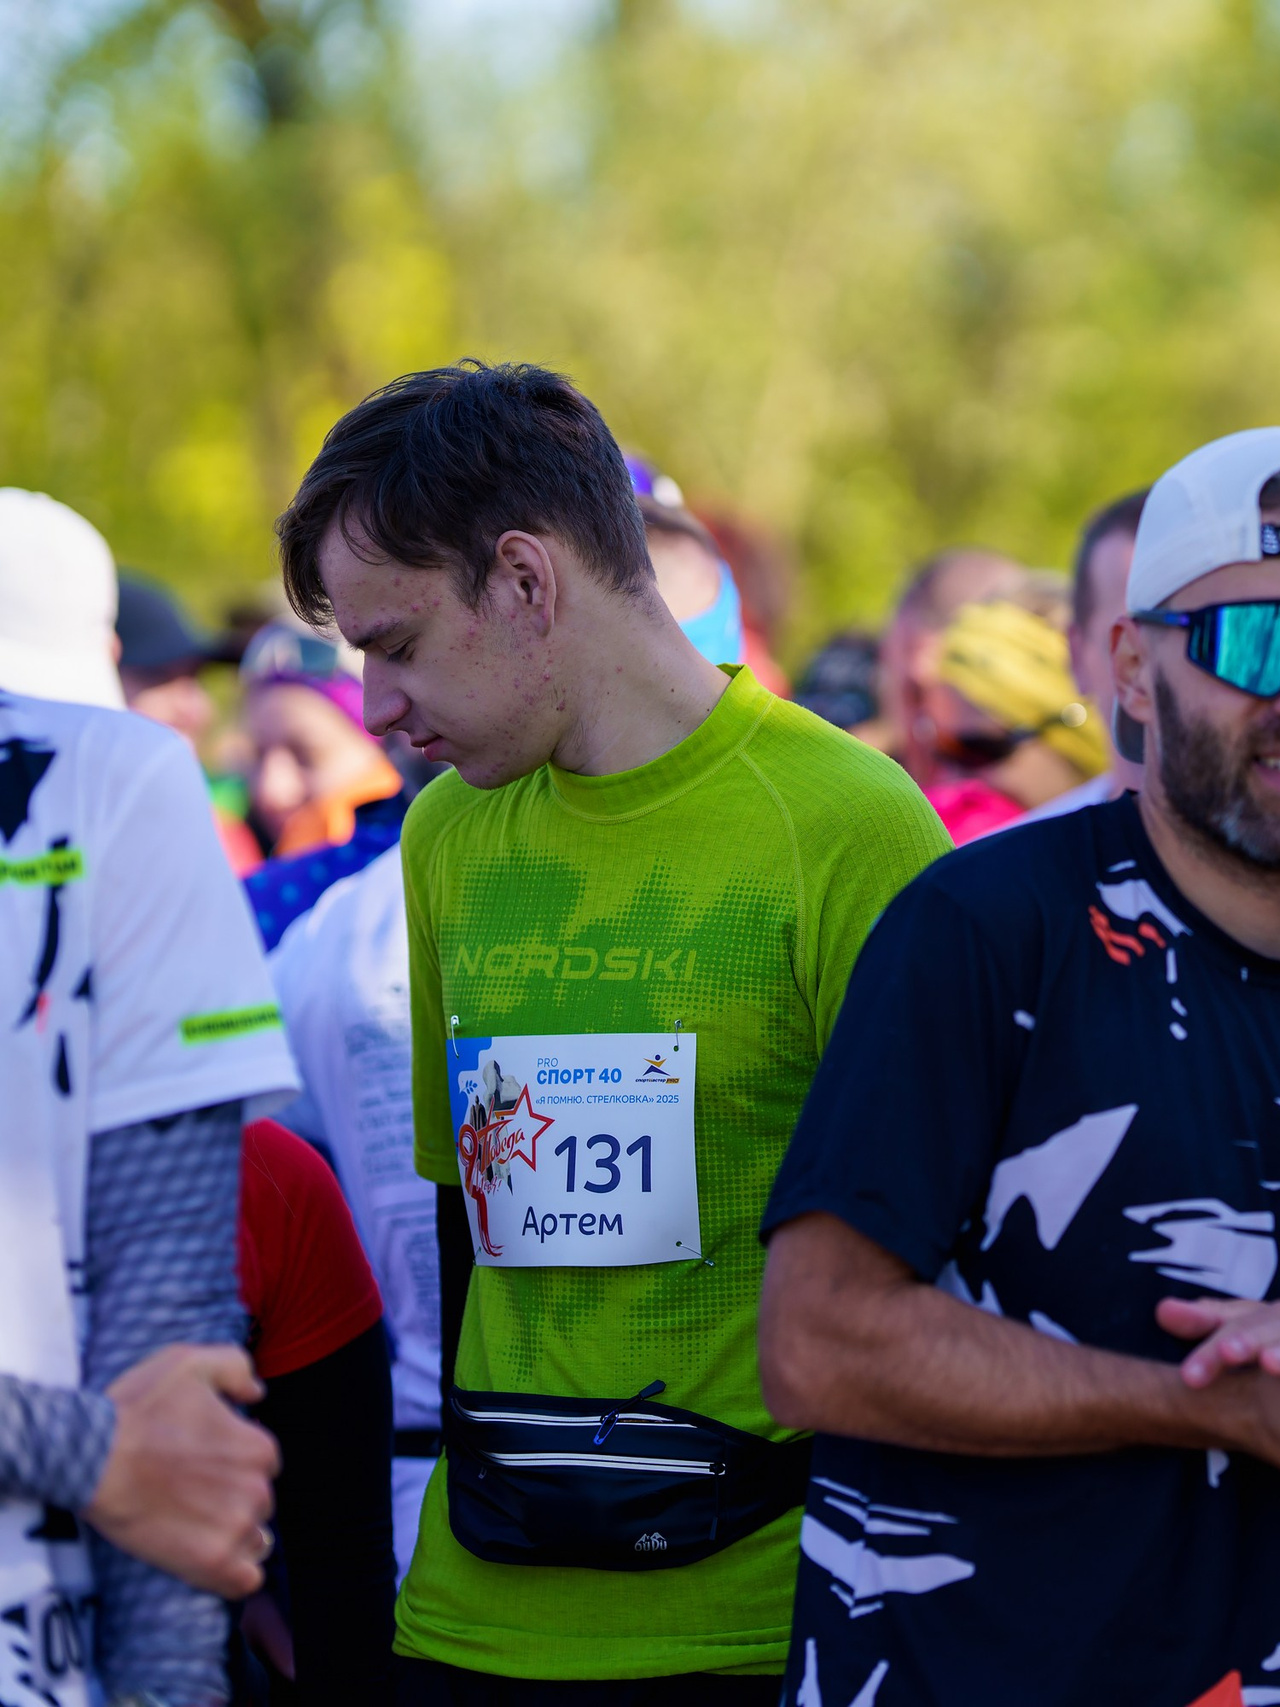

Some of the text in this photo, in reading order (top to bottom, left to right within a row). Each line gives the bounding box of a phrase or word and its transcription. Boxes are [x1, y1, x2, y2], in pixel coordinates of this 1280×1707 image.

[453, 946, 697, 981] NORDSKI
[537, 1058, 559, 1068] PRO
[537, 1068, 622, 1085] СПОРТ 40
[547, 1095, 584, 1105] ПОМНЮ.
[586, 1095, 654, 1105] СТРЕЛКОВКА»
[656, 1094, 680, 1104] 2025
[555, 1134, 652, 1193] 131
[522, 1206, 624, 1244] Артем
